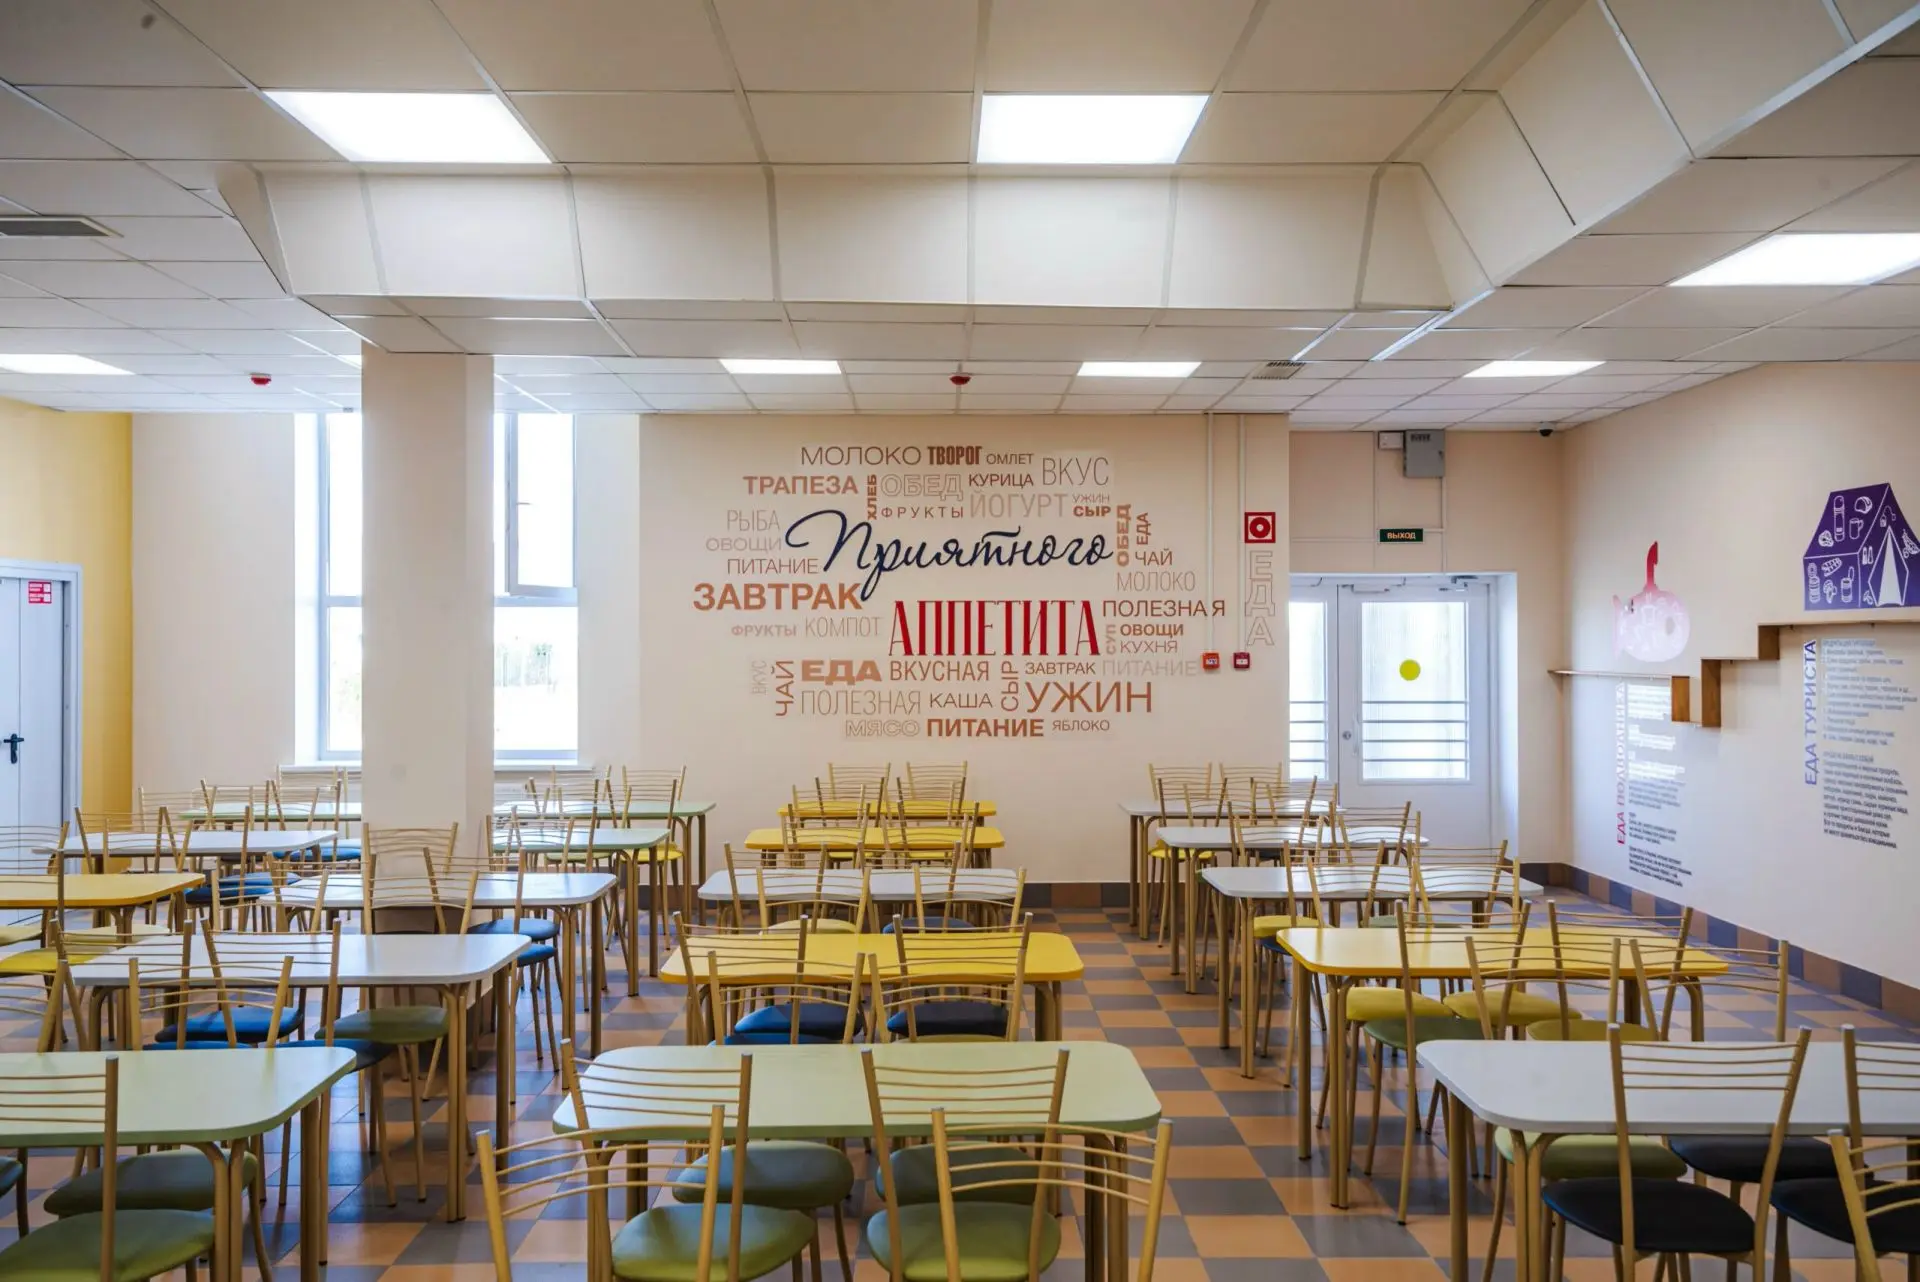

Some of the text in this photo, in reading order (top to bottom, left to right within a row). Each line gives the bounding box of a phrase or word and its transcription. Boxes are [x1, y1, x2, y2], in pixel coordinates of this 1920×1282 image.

[801, 446, 922, 466] МОЛОКО
[927, 445, 982, 466] ТВОРОГ
[986, 453, 1034, 465] ОМЛЕТ
[968, 474, 1034, 488] КУРИЦА
[1042, 457, 1109, 486] ВКУС
[743, 475, 858, 495] ТРАПЕЗА
[881, 473, 964, 501] ОБЕД
[866, 474, 878, 520] ХЛЕБ
[970, 490, 1068, 518] ЙОГУРТ
[1072, 493, 1110, 504] УЖИН
[727, 509, 781, 532] РЫБА
[881, 507, 964, 519] ФРУКТЫ
[1073, 506, 1112, 517] СЫР
[1116, 504, 1132, 567] ОБЕД
[1136, 513, 1151, 546] ЕДА
[1387, 532, 1416, 540] ВЫХОД
[705, 537, 782, 552] ОВОЩИ
[727, 558, 819, 574] ПИТАНИЕ
[785, 509, 1114, 602] Приятного
[1135, 548, 1173, 566] ЧАЙ
[1116, 571, 1196, 592] МОЛОКО
[693, 582, 863, 611] ЗАВТРАК
[1245, 550, 1276, 647] ЕДА
[1103, 600, 1226, 618] ПОЛЕЗНАЯ
[731, 624, 797, 637] ФРУКТЫ
[805, 616, 882, 638] КОМПОТ
[888, 600, 1101, 656] АППЕТИТА
[1120, 624, 1184, 638] ОВОЩИ
[1105, 624, 1117, 655] СУП
[1120, 640, 1178, 653] КУХНЯ
[752, 660, 768, 695] ВКУС
[801, 659, 882, 686] ЕДА
[890, 660, 989, 681] ВКУСНАЯ
[1025, 661, 1096, 675] ЗАВТРАК
[1102, 660, 1198, 677] ПИТАНИЕ
[771, 660, 794, 717] ЧАЙ
[1001, 660, 1019, 712] СЫР
[801, 690, 922, 715] ПОЛЕЗНАЯ
[929, 693, 993, 709] КАША
[1025, 681, 1152, 713] УЖИН
[1804, 639, 1819, 786] ЕДА ТУРИСТА
[845, 719, 921, 737] МЯСО
[927, 718, 1045, 737] ПИТАНИЕ
[1052, 719, 1110, 732] ЯБЛОКО
[1616, 811, 1626, 845] ЕДА
